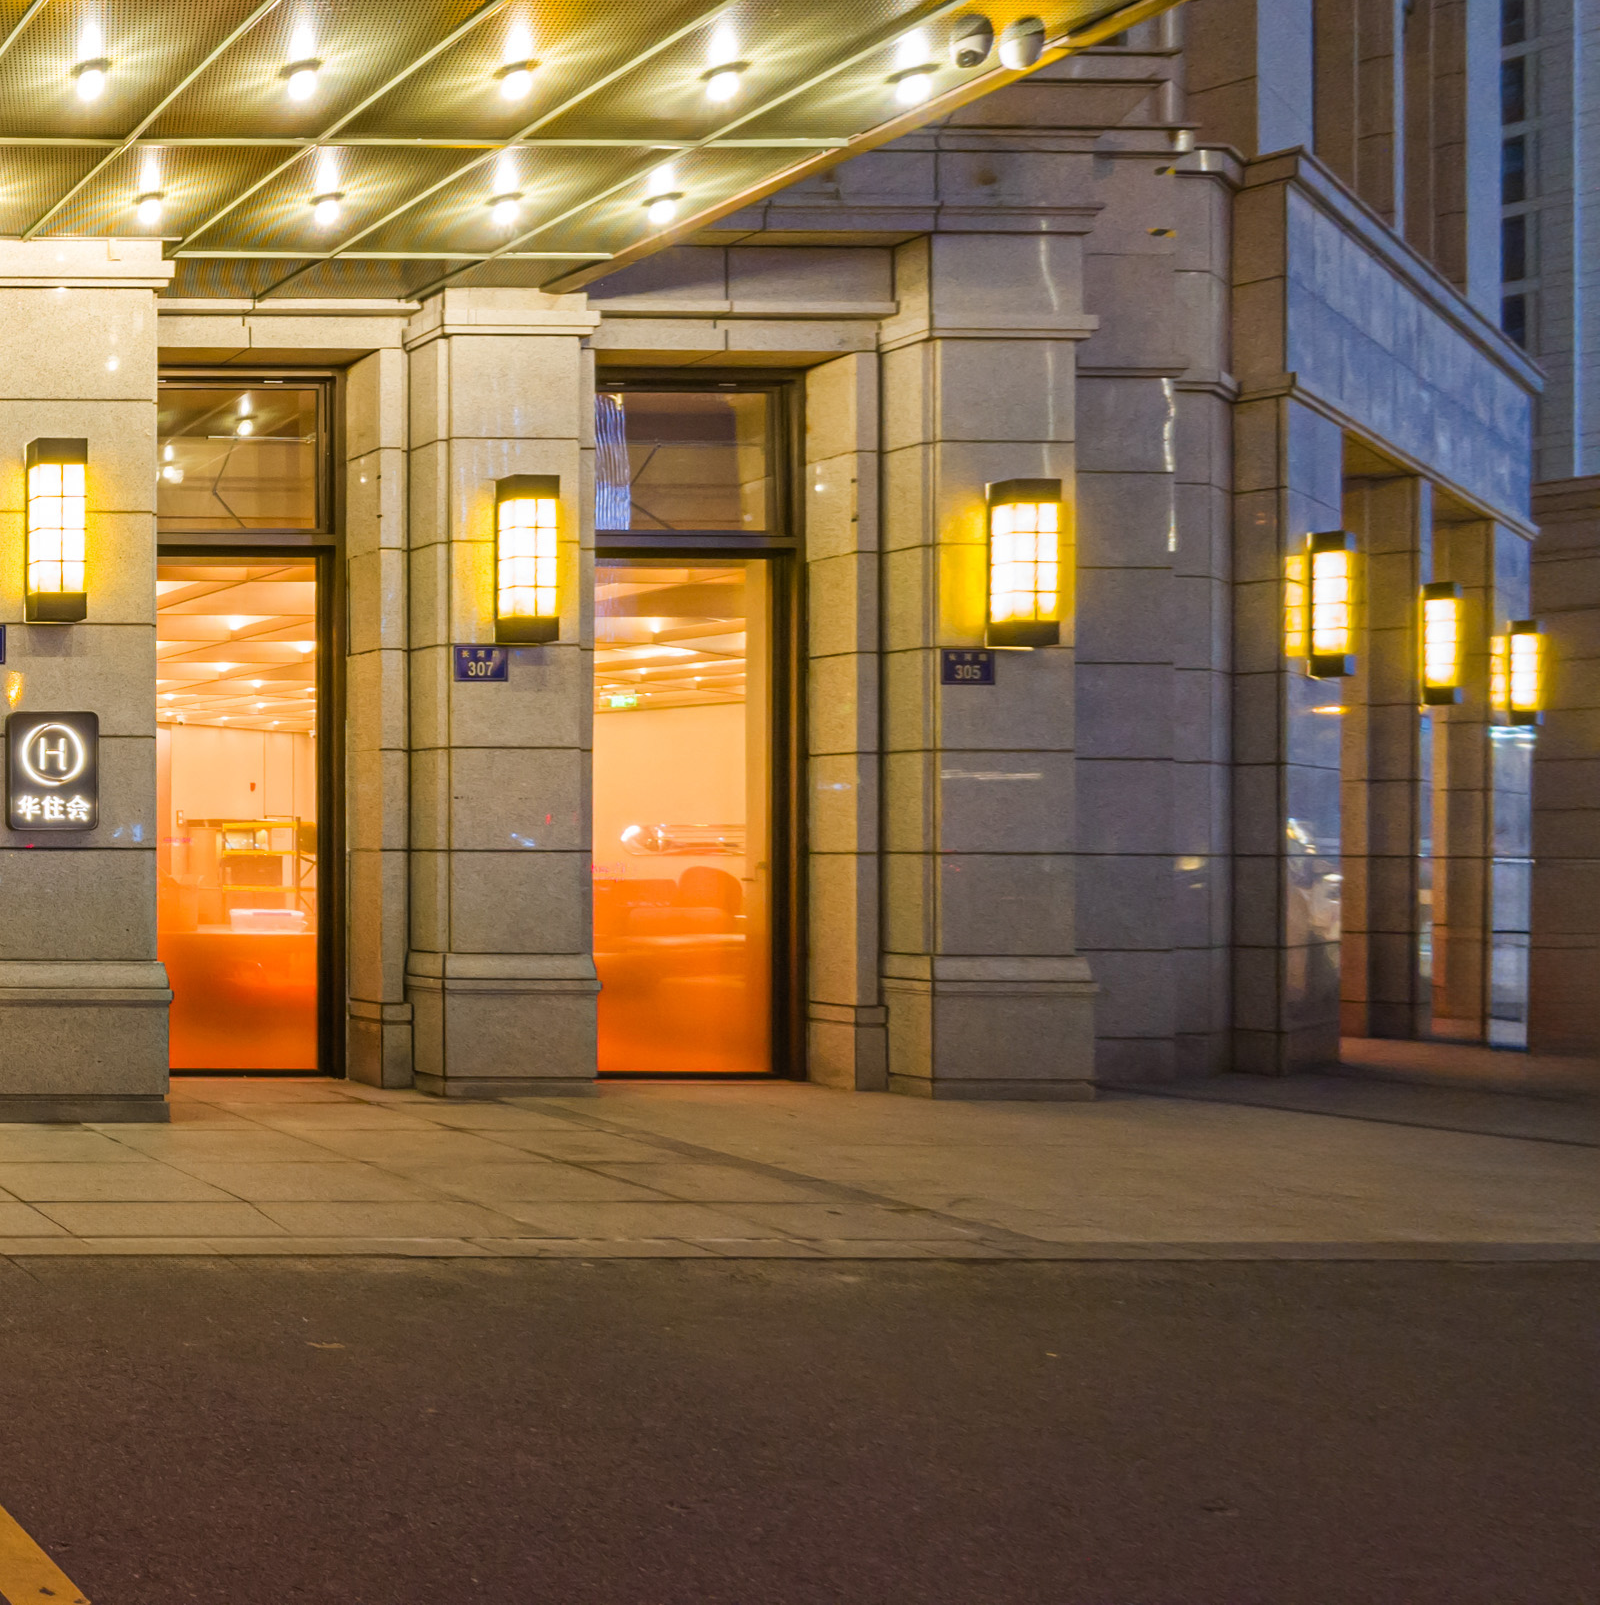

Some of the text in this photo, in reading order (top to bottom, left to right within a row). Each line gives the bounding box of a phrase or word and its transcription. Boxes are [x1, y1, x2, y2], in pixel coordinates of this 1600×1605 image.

[467, 661, 494, 677] 307
[954, 664, 982, 679] 305
[16, 794, 91, 822] 华住会
